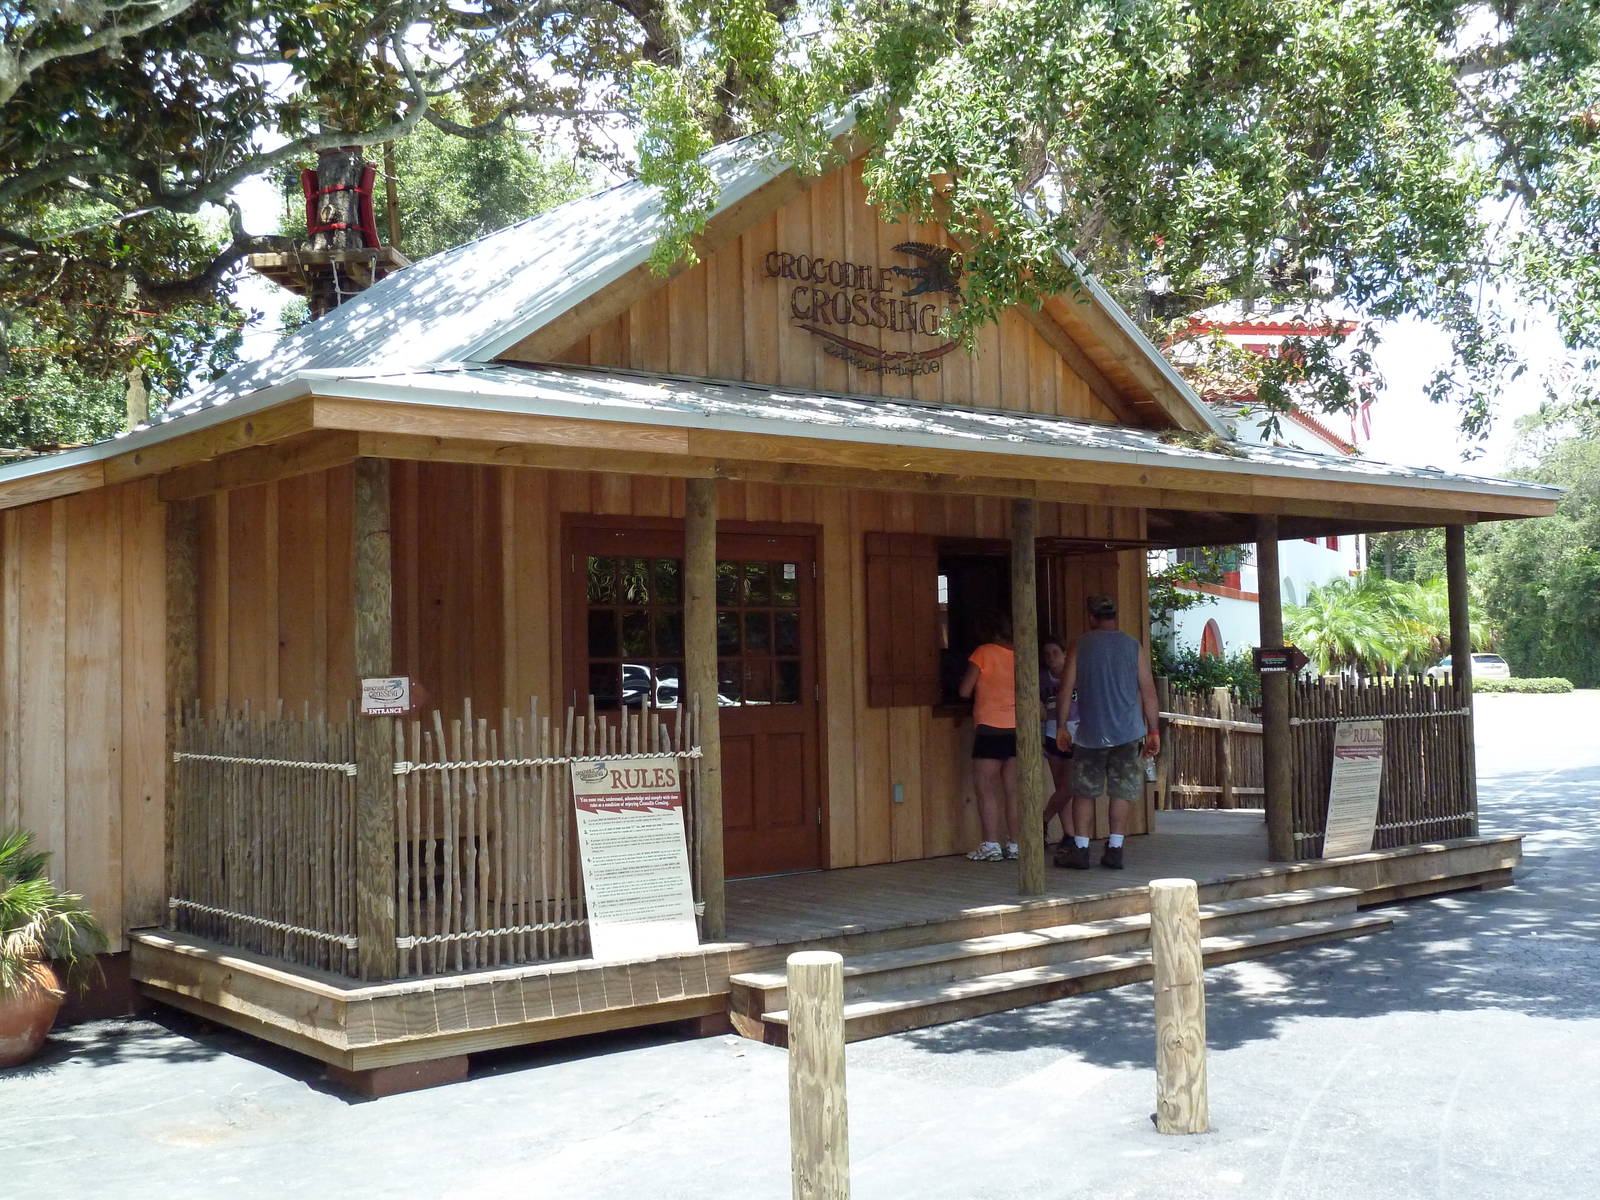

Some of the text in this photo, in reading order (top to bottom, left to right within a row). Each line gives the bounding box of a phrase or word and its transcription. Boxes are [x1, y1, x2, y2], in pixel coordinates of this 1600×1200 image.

[765, 250, 893, 293] CROCODILE
[790, 286, 938, 337] CROSSING
[1352, 728, 1382, 743] RULES
[610, 768, 676, 790] RULES
